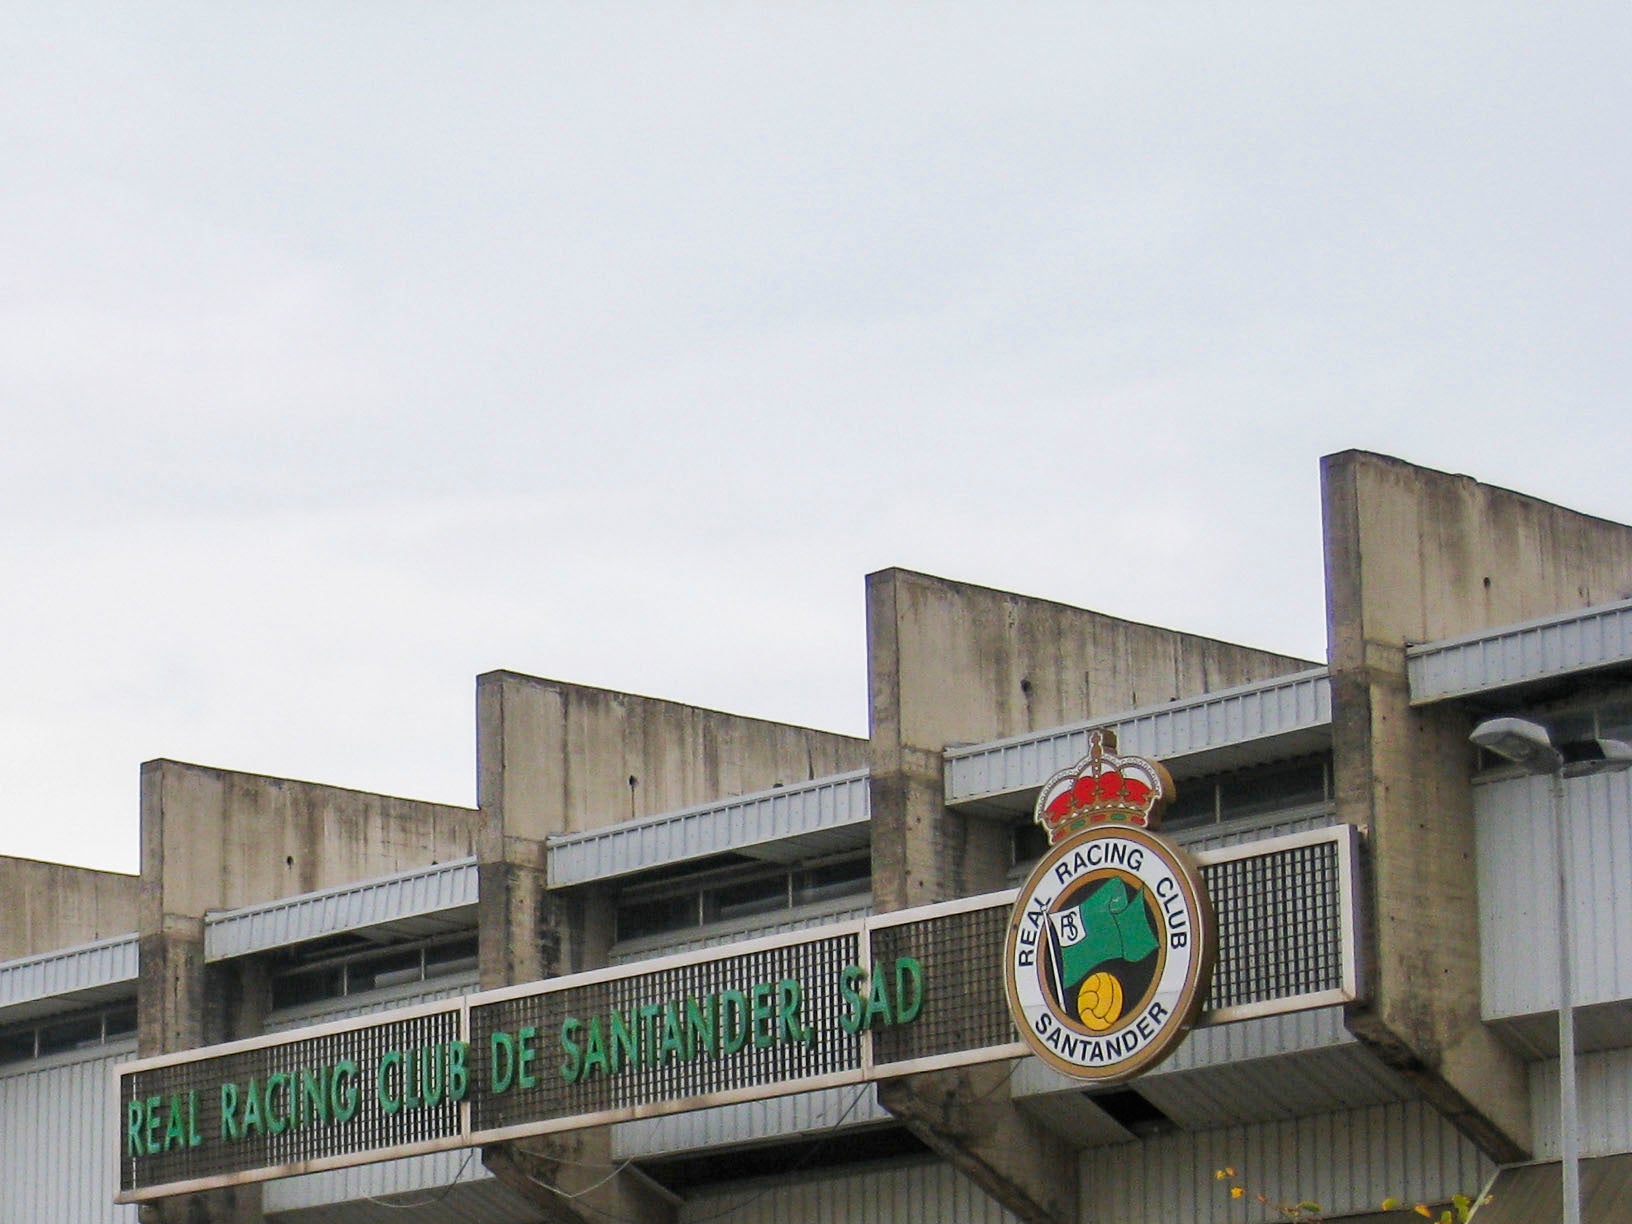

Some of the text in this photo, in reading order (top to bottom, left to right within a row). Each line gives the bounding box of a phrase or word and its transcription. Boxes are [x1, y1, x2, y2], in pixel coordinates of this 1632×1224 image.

[1018, 842, 1188, 967] REAL RACING CLUB
[127, 957, 926, 1157] REAL RACING CLUB DE SANTANDER, SAD
[1035, 1001, 1168, 1063] SANTANDER
